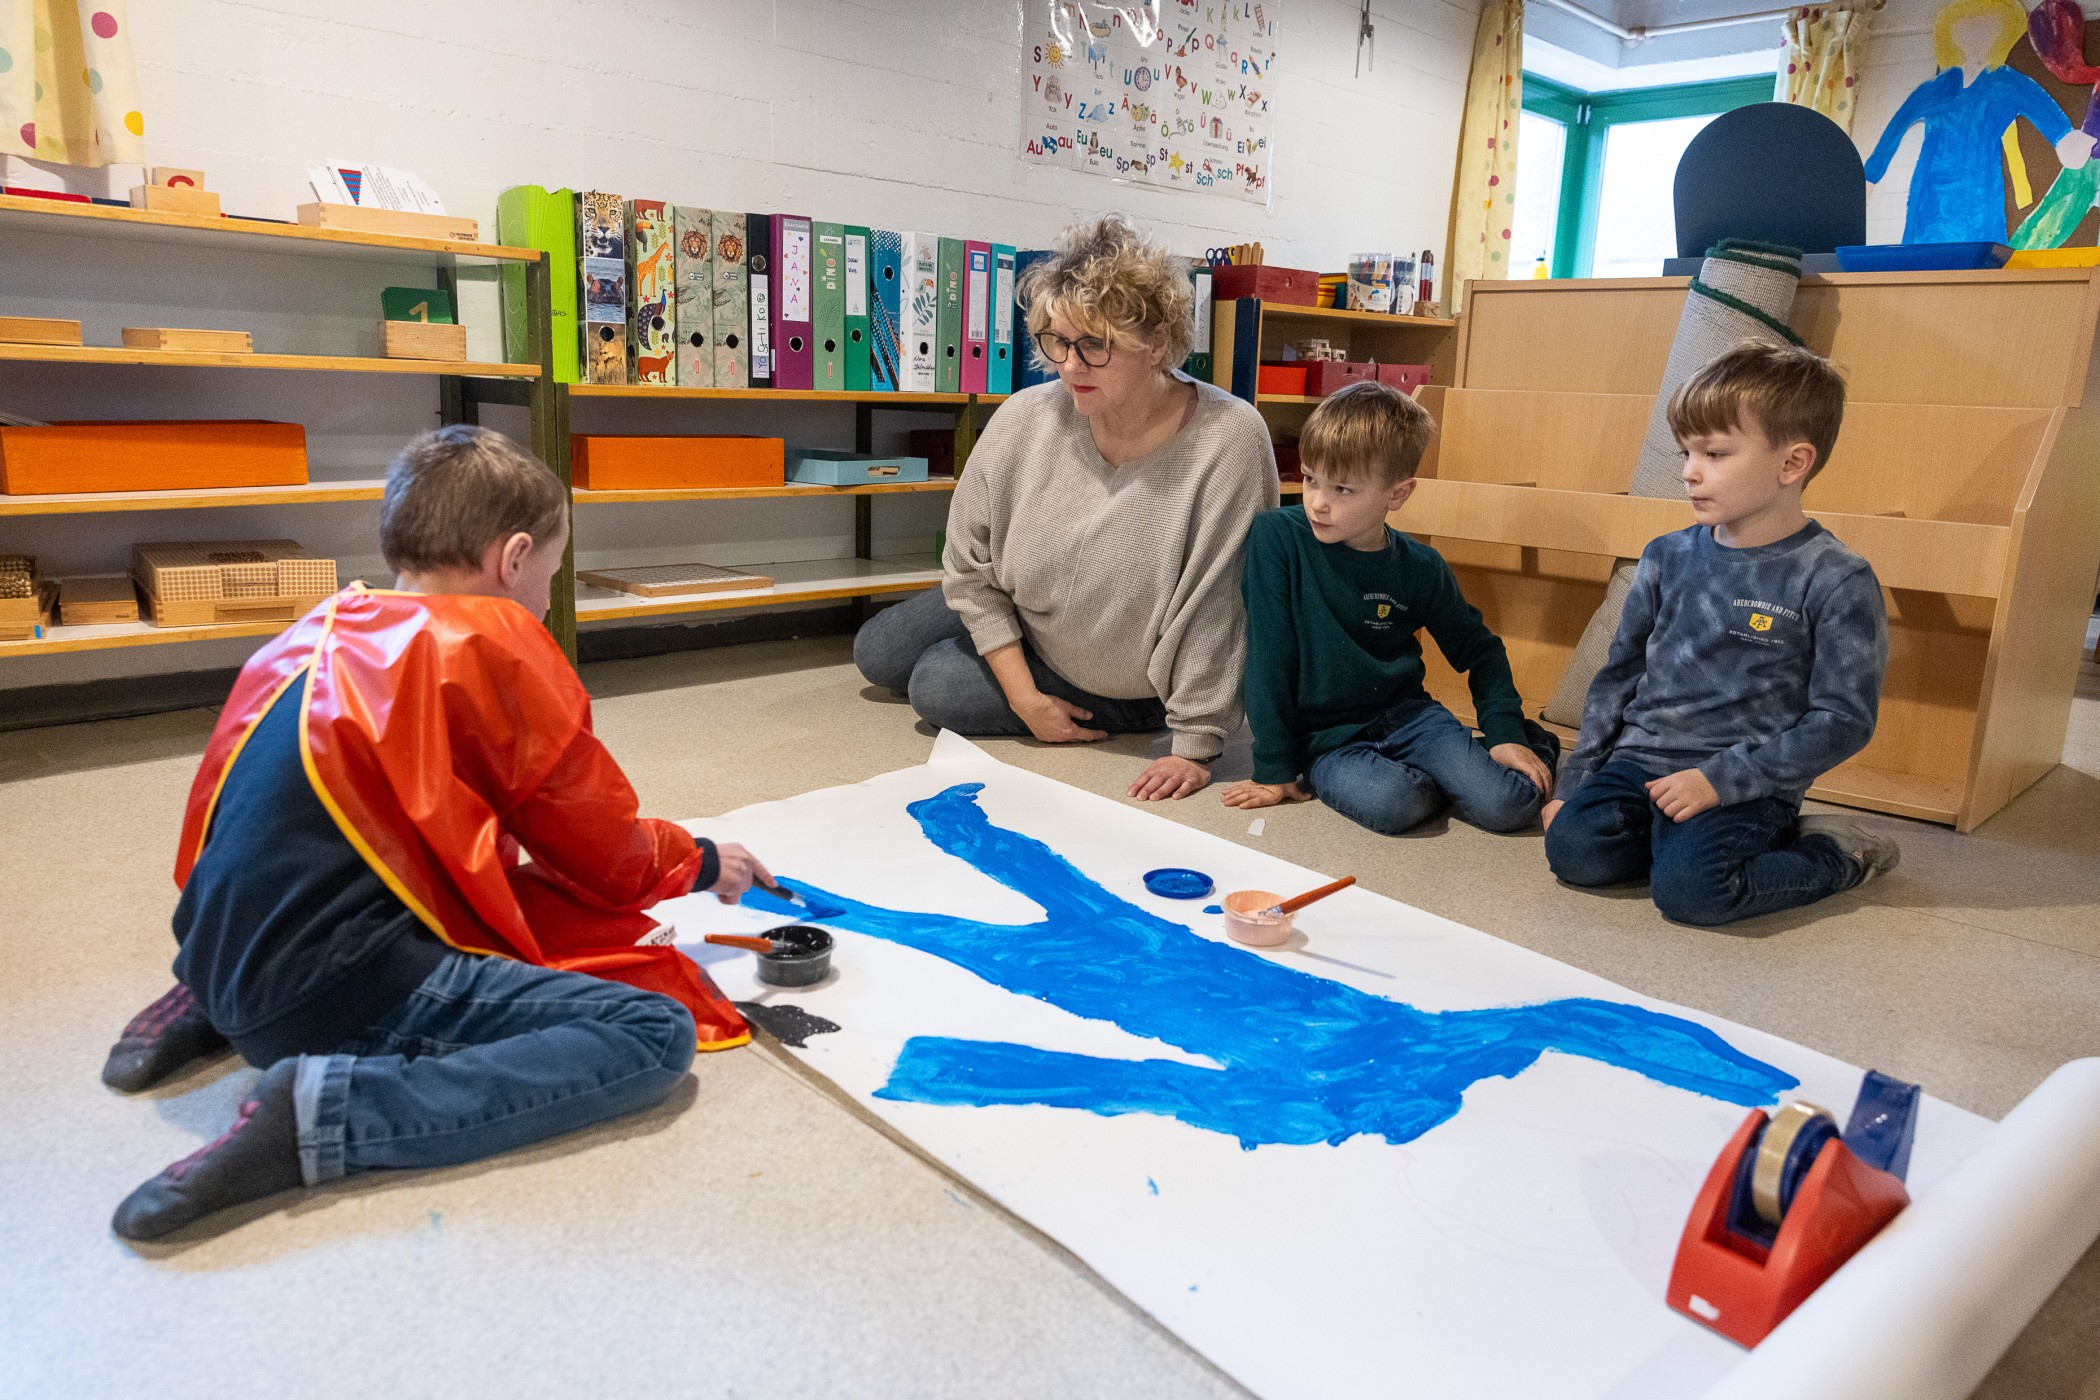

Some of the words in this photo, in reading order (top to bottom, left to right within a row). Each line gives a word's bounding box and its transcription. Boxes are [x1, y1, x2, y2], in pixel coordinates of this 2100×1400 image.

[1206, 7, 1214, 24] K
[1245, 3, 1250, 18] L
[1113, 14, 1121, 28] n
[1205, 34, 1215, 51] Q
[1034, 46, 1042, 63] S
[1231, 52, 1238, 67] q
[1242, 59, 1248, 75] R
[1266, 59, 1269, 70] r
[1033, 75, 1041, 92] Y
[1121, 93, 1129, 111] Ä
[1046, 123, 1057, 131] Auto
[1200, 112, 1206, 128] Ü
[1161, 121, 1169, 137] Ö
[1058, 136, 1072, 149] au
[1077, 130, 1087, 145] Eu
[1258, 137, 1267, 149] ei
[1026, 140, 1043, 155] Au
[1100, 146, 1113, 159] eu
[1160, 148, 1168, 161] St
[1237, 141, 1245, 154] Ei
[1116, 156, 1129, 173] Sp
[1146, 153, 1156, 167] sp
[1185, 161, 1193, 173] st
[1217, 168, 1233, 180] sch
[1236, 163, 1245, 176] Pf
[1196, 171, 1213, 187] Sch
[1255, 176, 1266, 189] pf
[1733, 599, 1771, 611] ABERCROMBIE
[1771, 604, 1783, 615] AND
[1782, 608, 1800, 621] FITCH
[1729, 629, 1769, 643] ESTABLISHED
